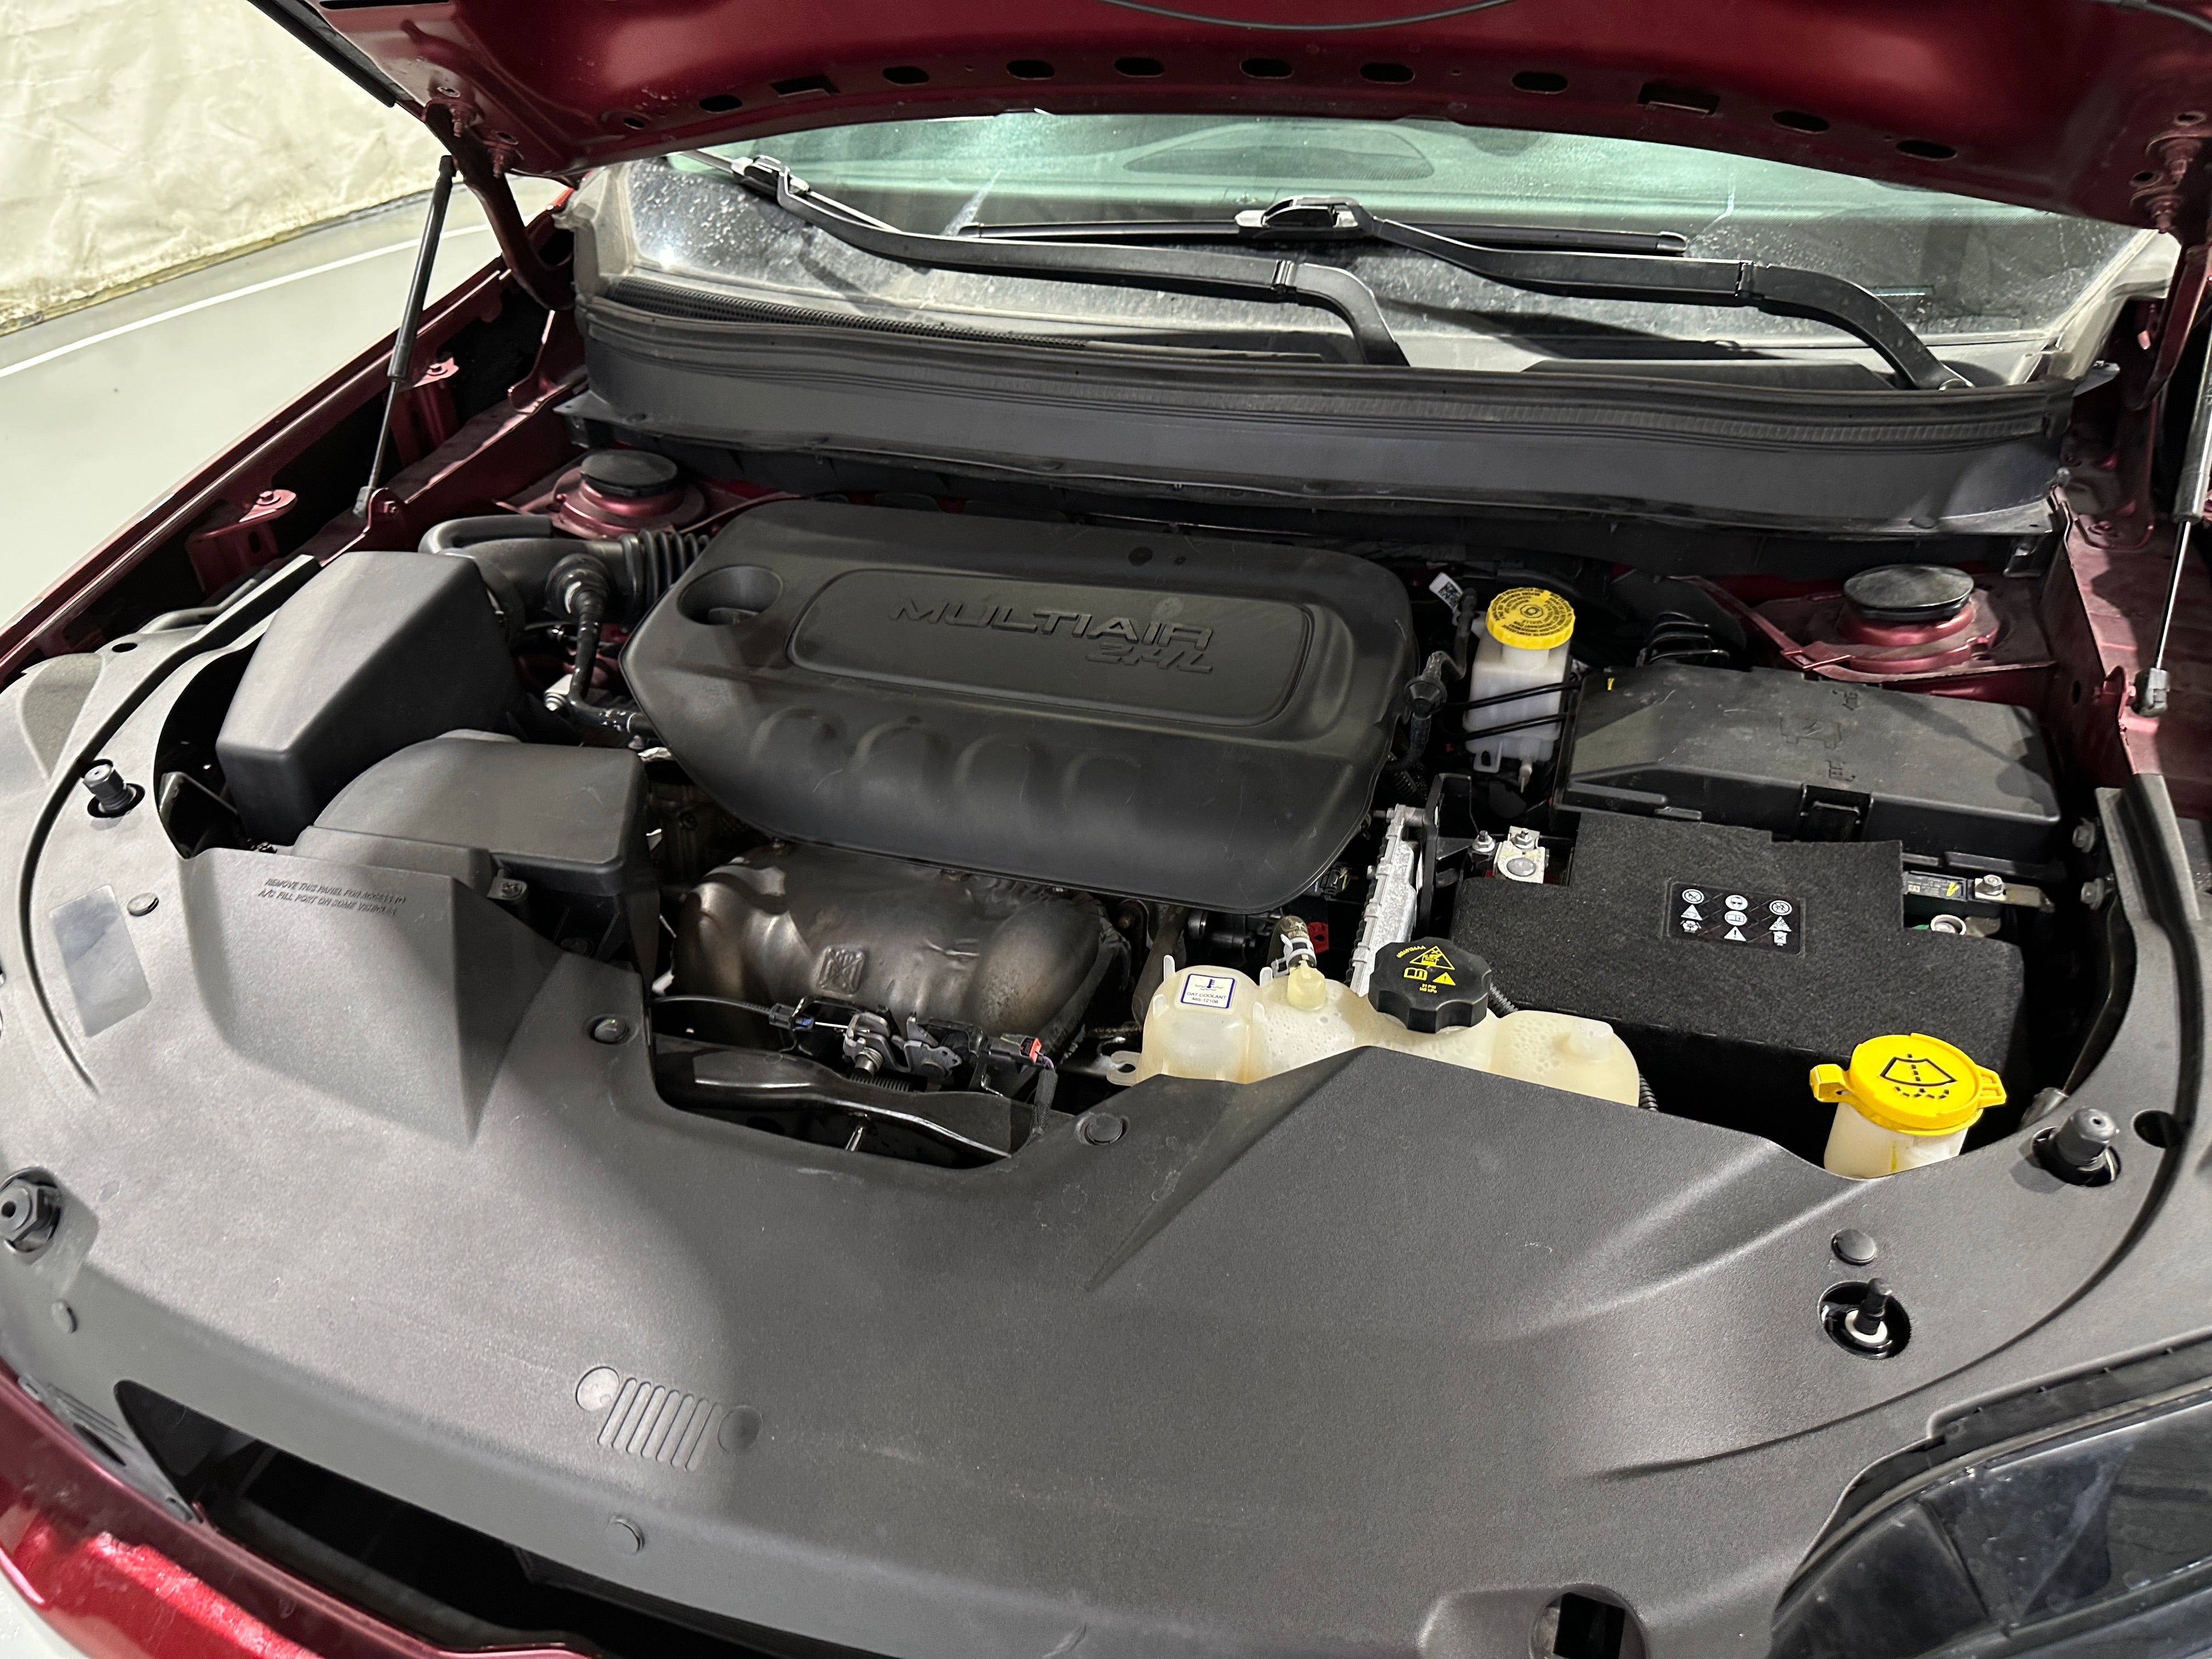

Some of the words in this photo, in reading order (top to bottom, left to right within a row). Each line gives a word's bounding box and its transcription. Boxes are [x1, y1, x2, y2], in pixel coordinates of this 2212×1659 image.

[889, 599, 1213, 651] MULTIAIR
[1086, 641, 1213, 674] 2.4L
[258, 888, 276, 898] A/C
[276, 891, 294, 901] FILL
[294, 894, 318, 905] PORT
[318, 897, 332, 907] ON
[331, 899, 357, 910] SOME
[264, 878, 299, 890] REMOVE
[298, 883, 318, 893] THIS
[317, 885, 342, 896] PANEL
[343, 889, 362, 899] FOR
